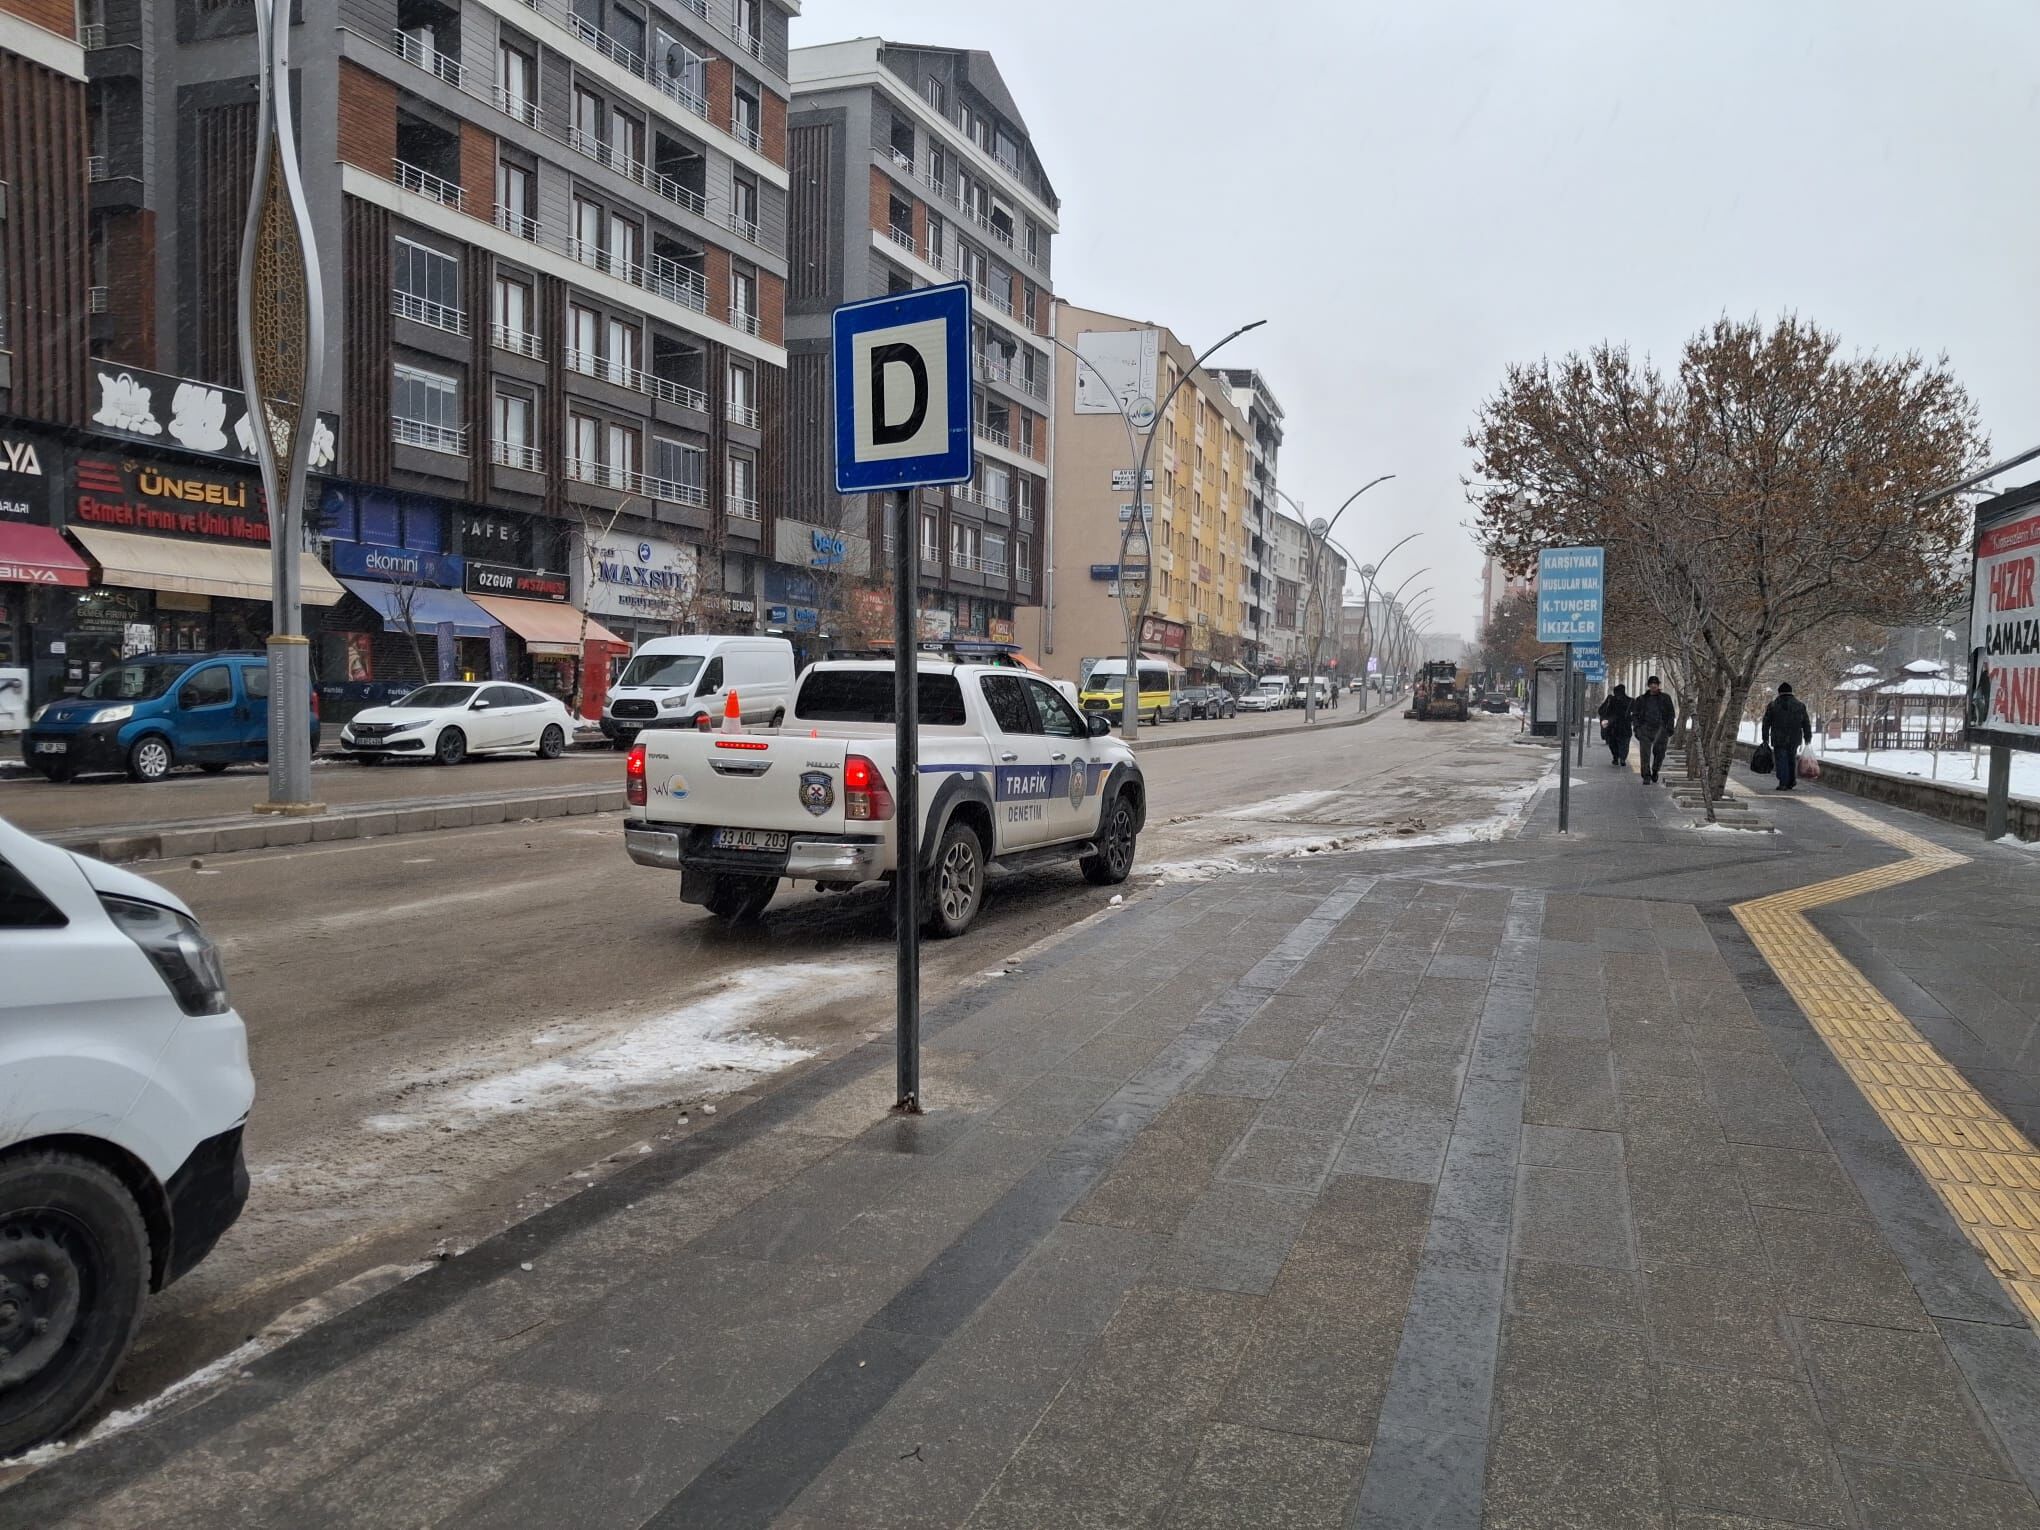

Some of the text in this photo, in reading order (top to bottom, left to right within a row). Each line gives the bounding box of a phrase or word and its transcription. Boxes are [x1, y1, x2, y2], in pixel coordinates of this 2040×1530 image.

[871, 342, 929, 446] D
[139, 467, 246, 508] ÜNSELİ
[78, 495, 133, 525] Ekmek
[366, 550, 418, 573] ekomini
[1544, 556, 1598, 572] KARŞIYAKA
[1988, 555, 2035, 613] HIZIR
[1006, 771, 1047, 795] TRAFİK
[720, 830, 735, 845] 33
[764, 834, 787, 849] 203
